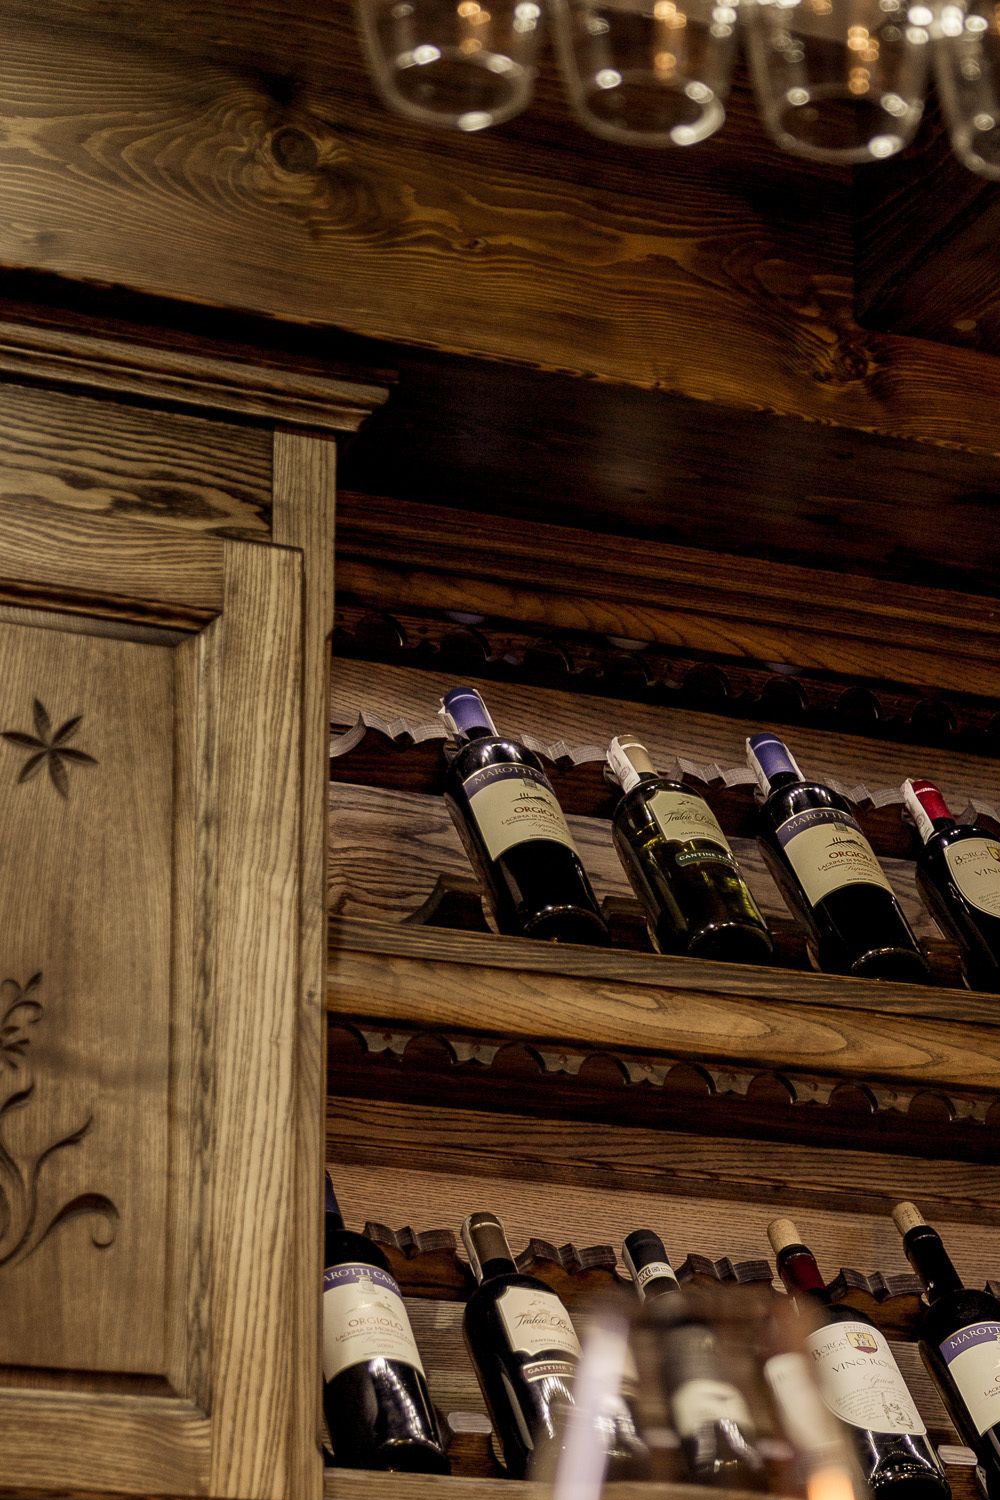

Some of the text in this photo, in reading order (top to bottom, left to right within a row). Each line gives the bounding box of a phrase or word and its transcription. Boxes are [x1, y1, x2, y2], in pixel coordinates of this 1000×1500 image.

[473, 766, 533, 785] MAROTTI
[787, 811, 842, 832] MAROTTI
[679, 852, 715, 861] CANTINE
[323, 1267, 371, 1282] AROTTI
[348, 1316, 404, 1331] ORGIOLO
[527, 1365, 567, 1375] CANTINE
[832, 1358, 867, 1373] VINO
